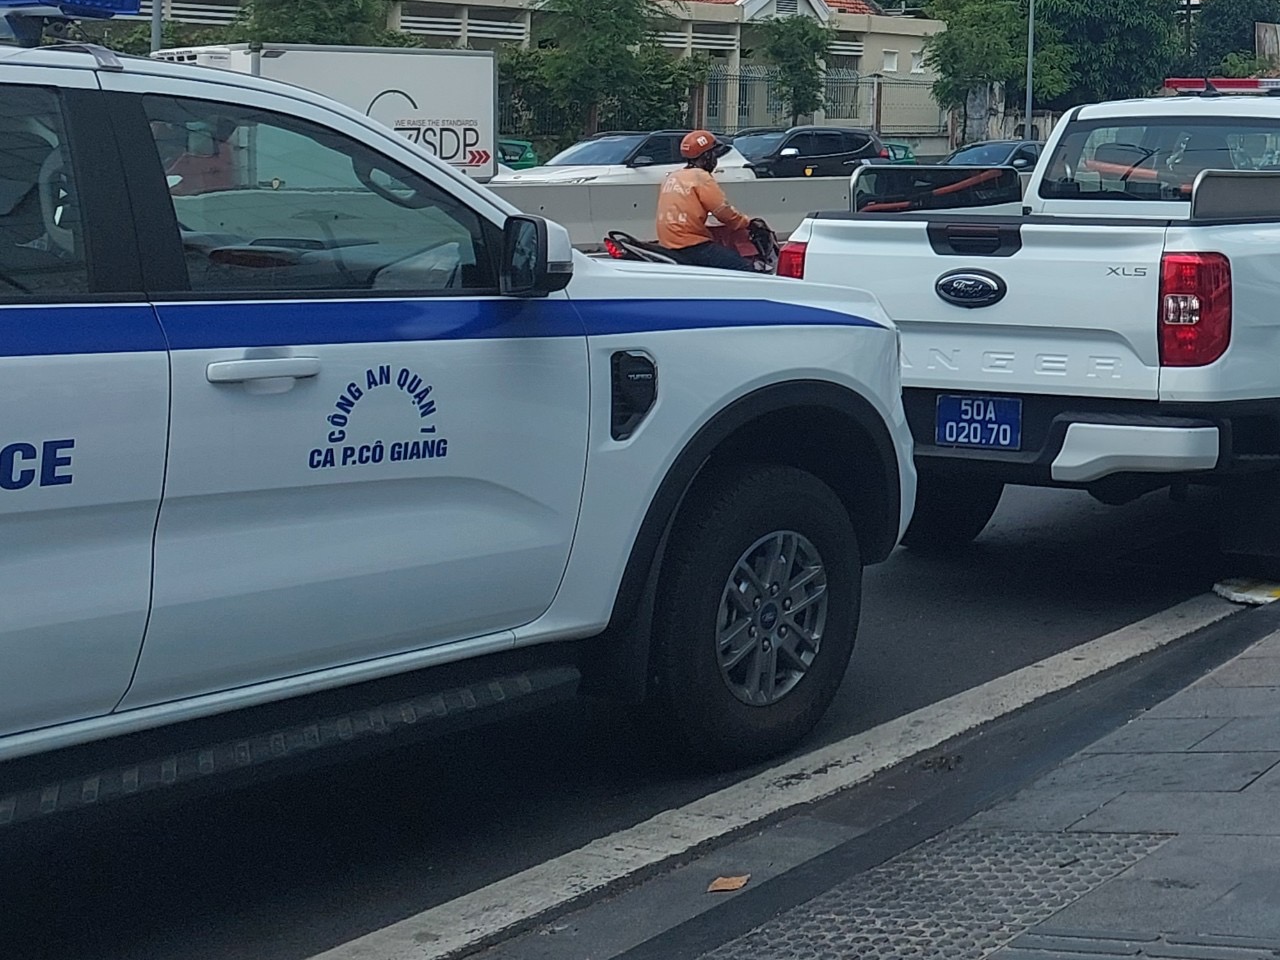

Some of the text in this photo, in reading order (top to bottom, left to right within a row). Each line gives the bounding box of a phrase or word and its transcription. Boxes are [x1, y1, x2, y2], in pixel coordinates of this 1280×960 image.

[1106, 266, 1148, 277] XLS
[327, 365, 437, 443] CÔNG AN QUẬN 1
[960, 399, 996, 422] 50A
[945, 421, 1011, 446] 020.70
[308, 438, 448, 469] CA P.CÔ GIANG
